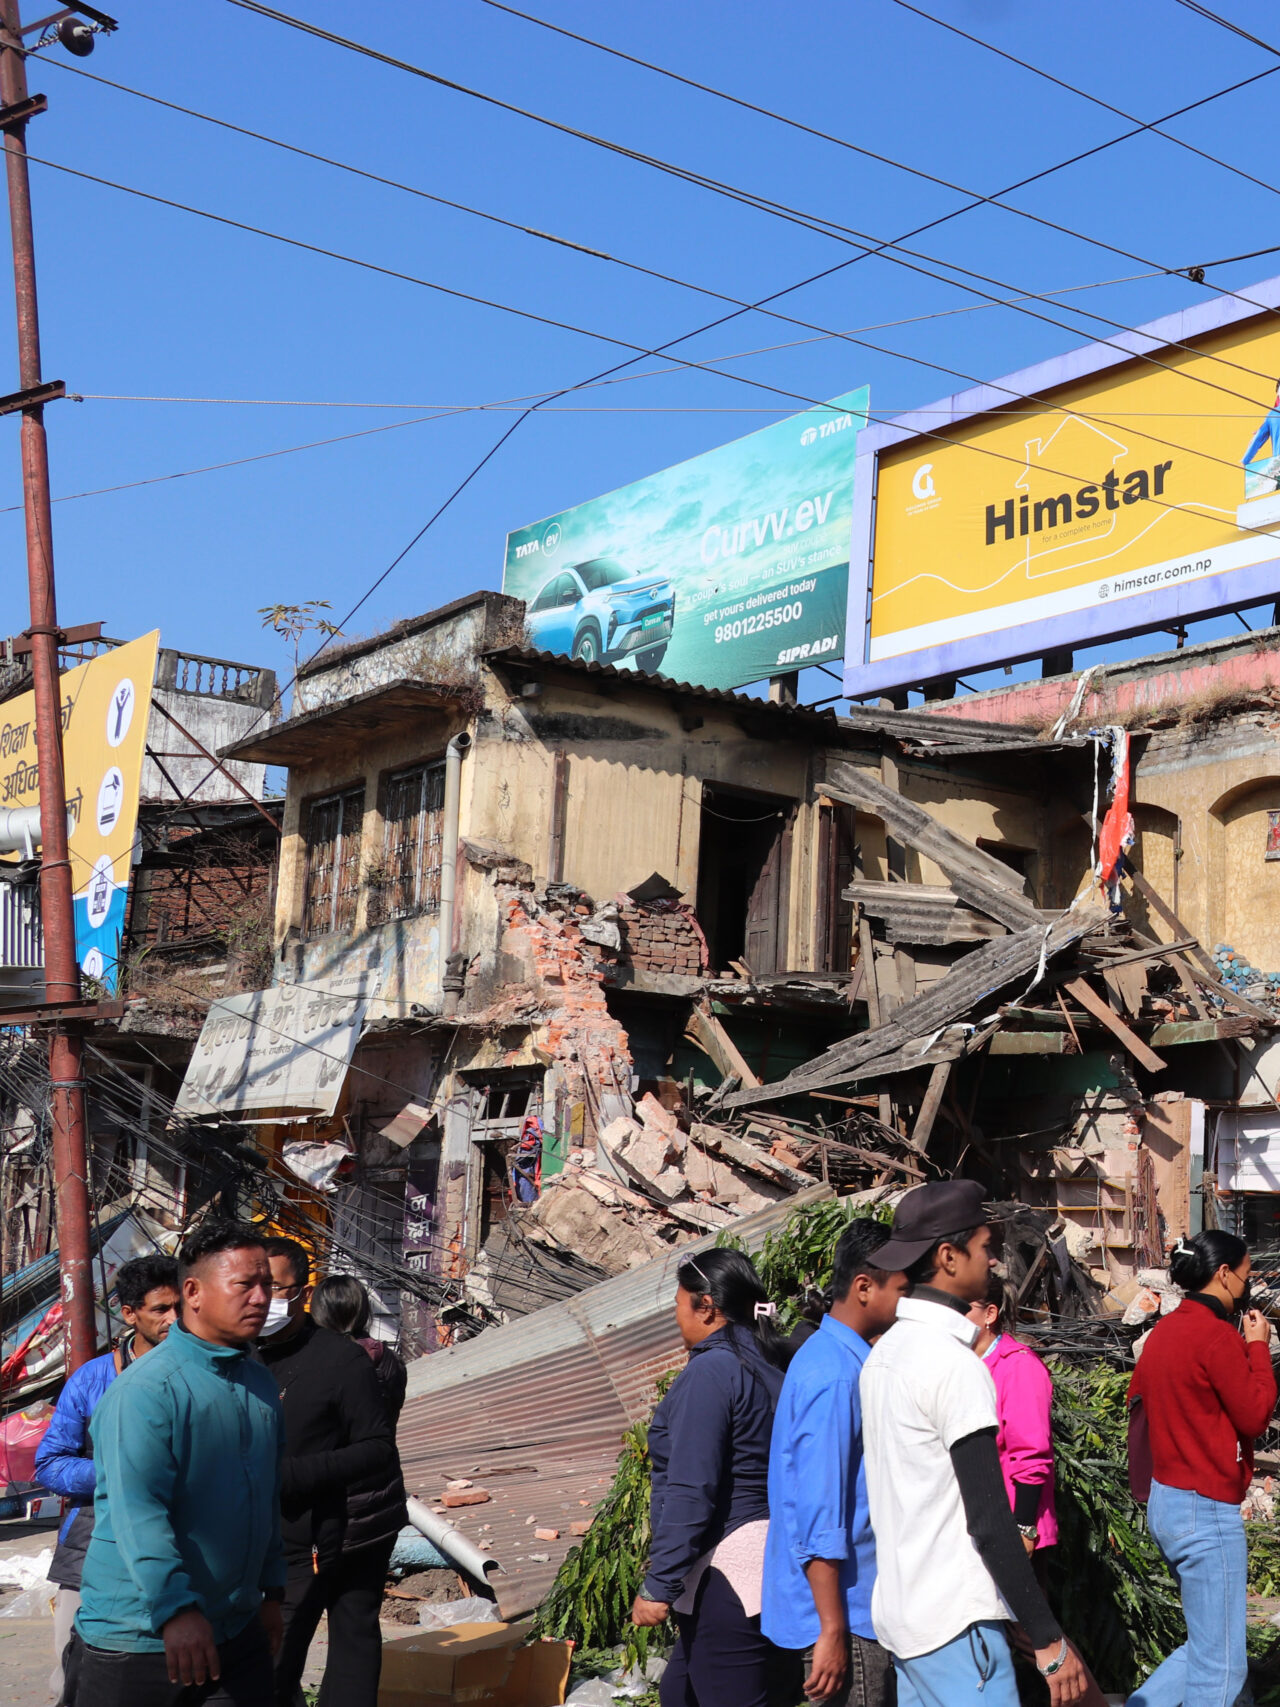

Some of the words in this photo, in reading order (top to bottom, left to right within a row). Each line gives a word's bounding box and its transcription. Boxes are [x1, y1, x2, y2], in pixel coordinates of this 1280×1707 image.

[819, 413, 853, 439] TATA
[985, 460, 1173, 546] Himstar
[700, 491, 833, 564] Curvv.ev
[1042, 535, 1051, 544] for
[1059, 524, 1091, 538] complete
[1092, 517, 1112, 530] home
[762, 567, 775, 580] an
[776, 555, 806, 575] SUV's
[808, 544, 842, 563] stance
[1114, 558, 1212, 594] himstar.com.np
[704, 608, 718, 626] get
[719, 603, 745, 623] yours
[746, 585, 789, 610] delivered
[790, 578, 817, 595] today
[714, 601, 803, 644] 9801225500
[776, 634, 838, 666] SIPRADI
